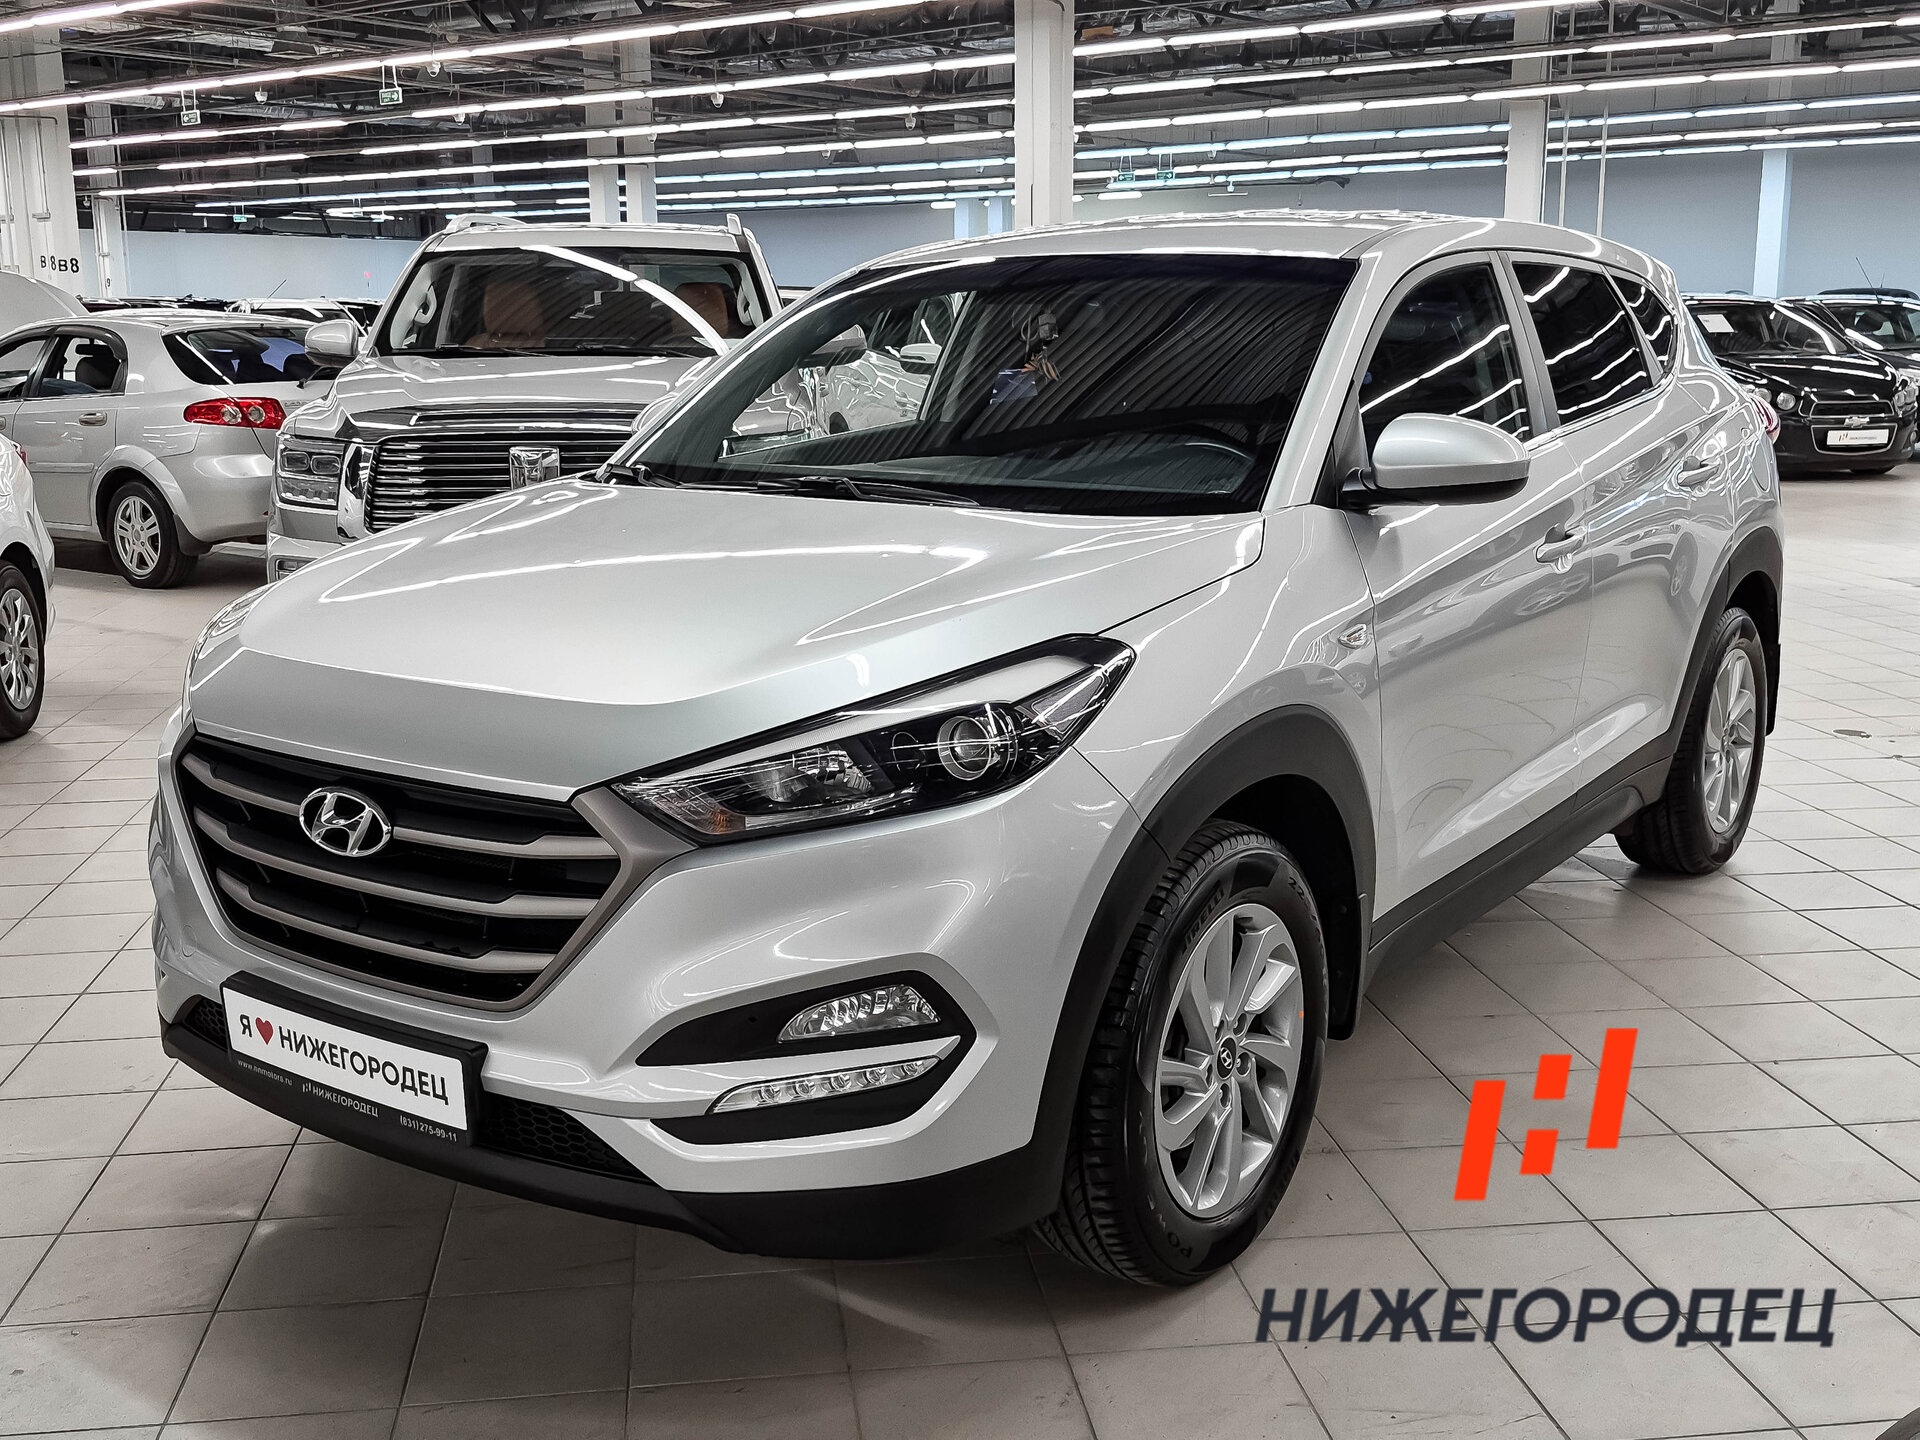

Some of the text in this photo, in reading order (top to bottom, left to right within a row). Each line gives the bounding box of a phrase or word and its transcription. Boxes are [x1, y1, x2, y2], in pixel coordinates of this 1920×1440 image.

[239, 1014, 450, 1106] Я НИЖЕГОРОДЕЦ
[312, 1085, 379, 1118] НИЖЕГОРОДЕЦ
